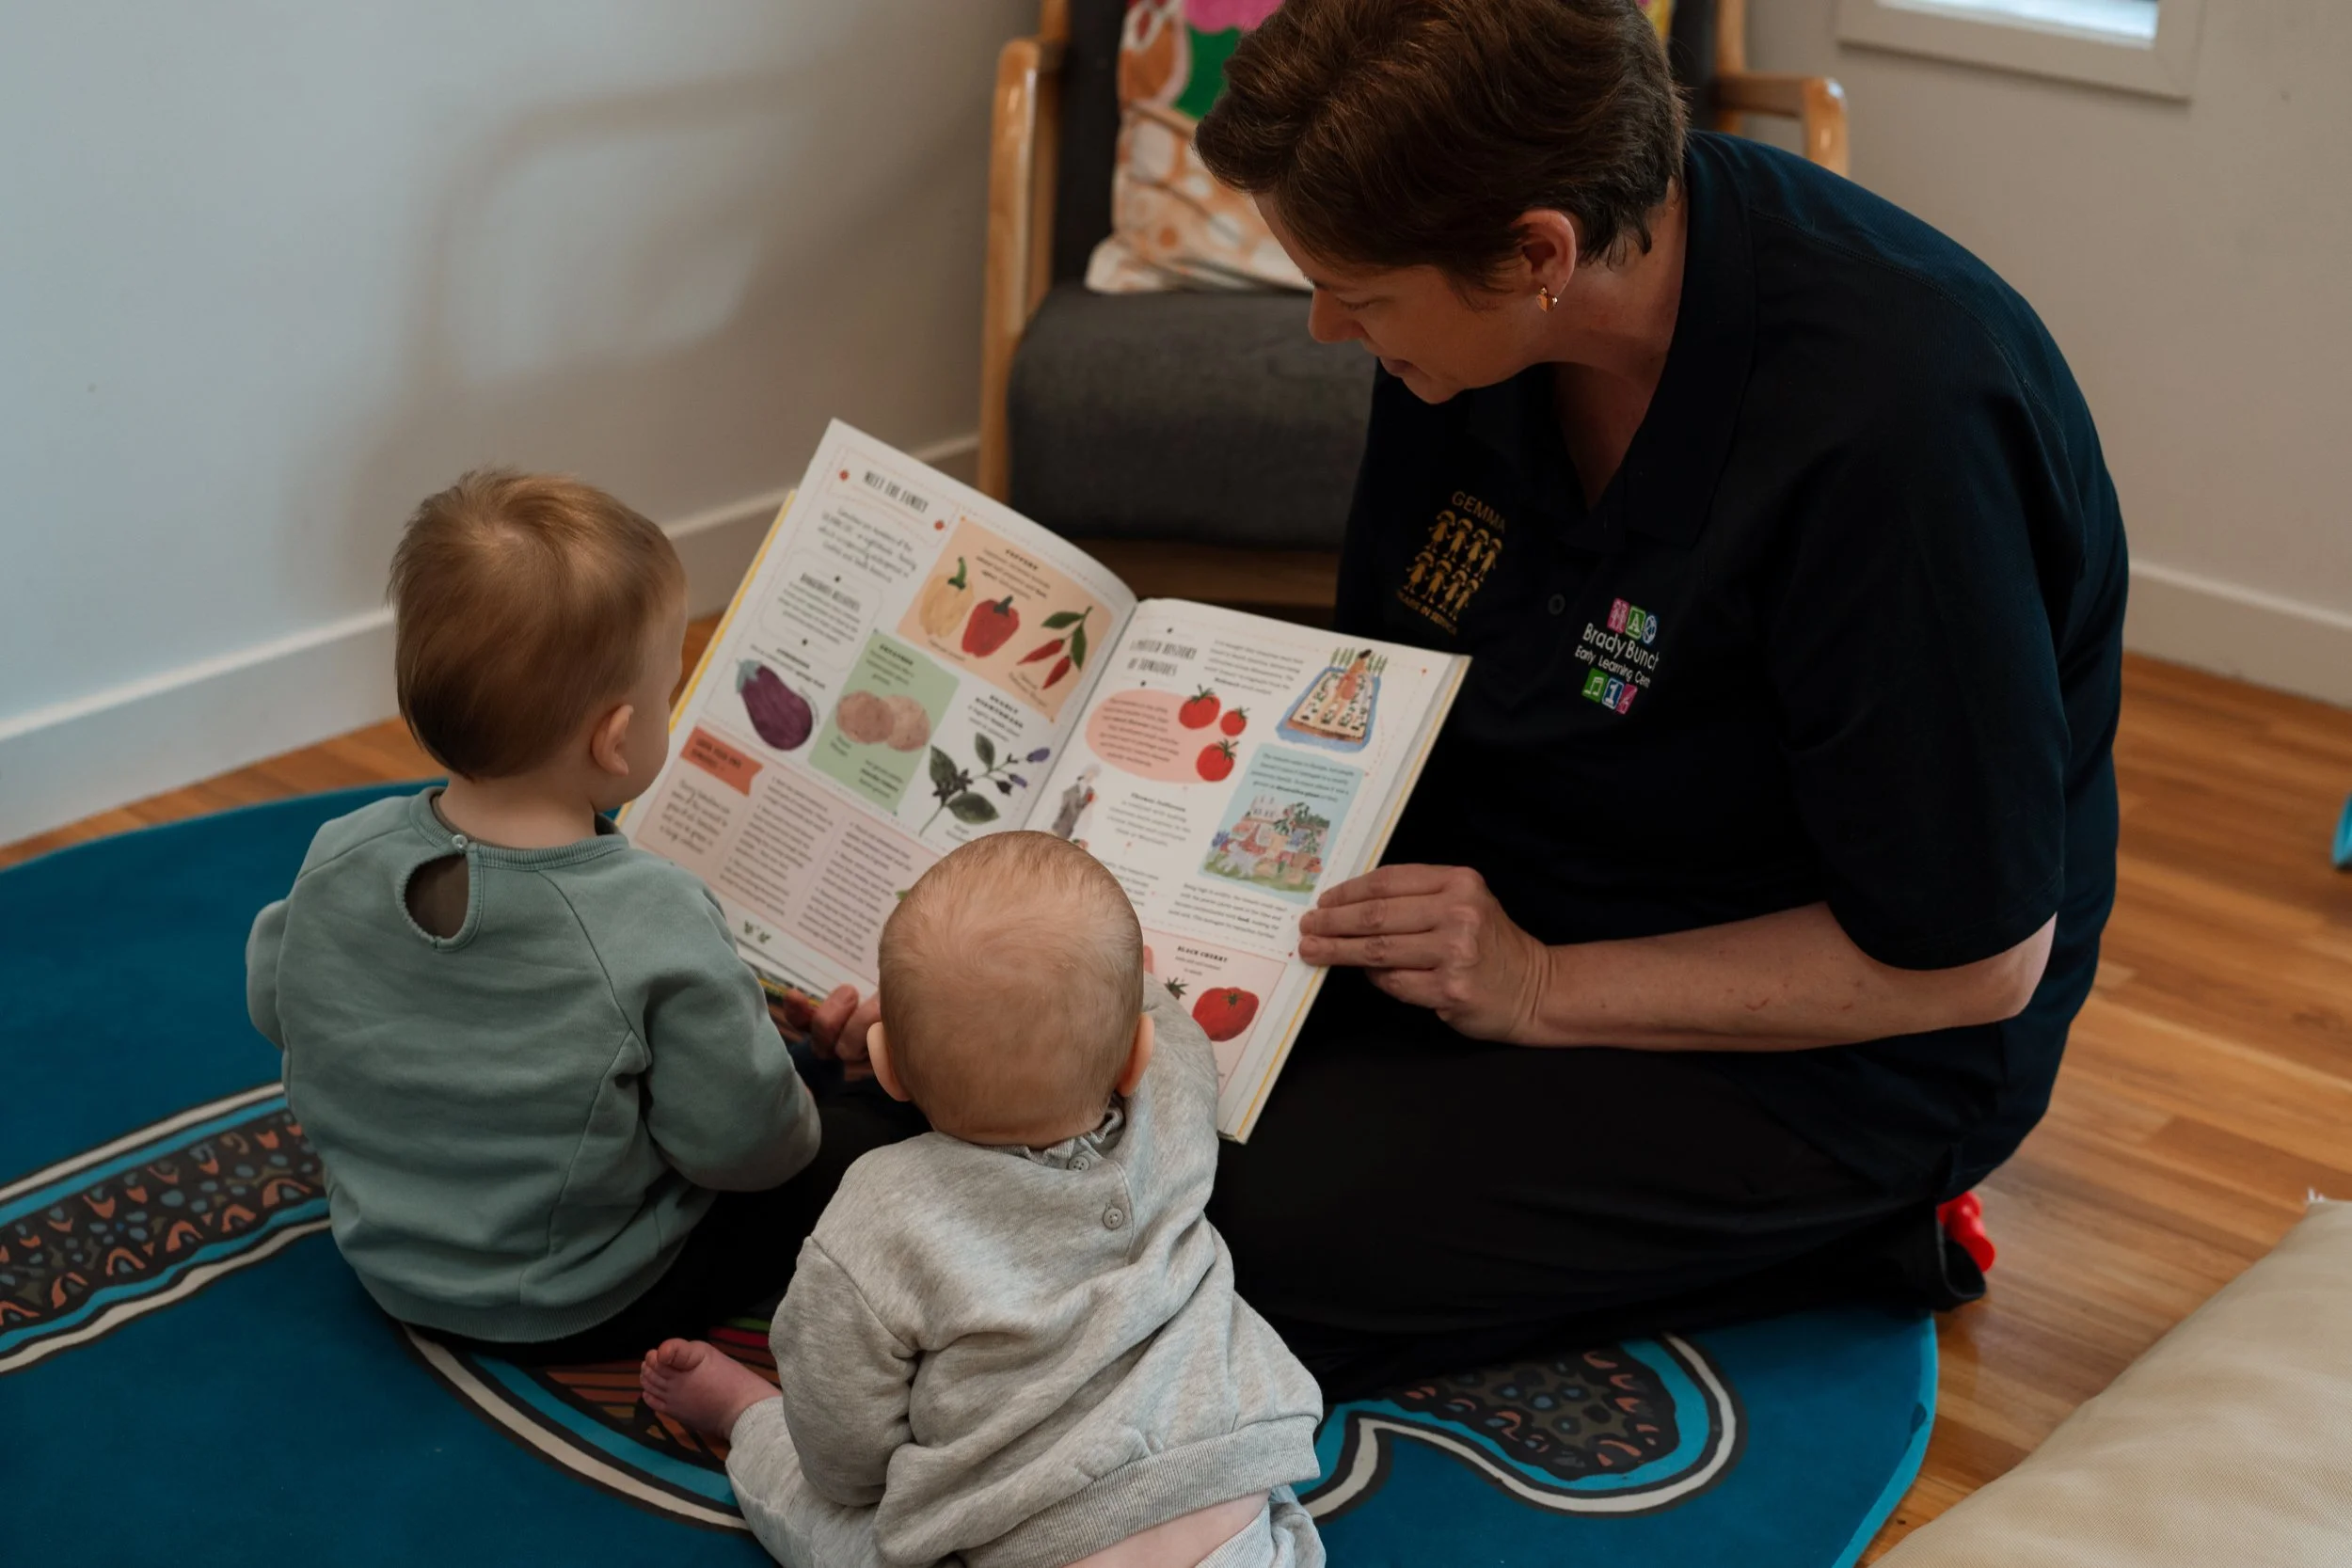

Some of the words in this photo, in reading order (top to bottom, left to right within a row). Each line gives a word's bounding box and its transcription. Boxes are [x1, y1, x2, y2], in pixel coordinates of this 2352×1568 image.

[1451, 490, 1505, 534] GEMMA
[1582, 623, 1626, 657] Brady
[1575, 644, 1597, 664] Early
[1598, 655, 1633, 681] Learning
